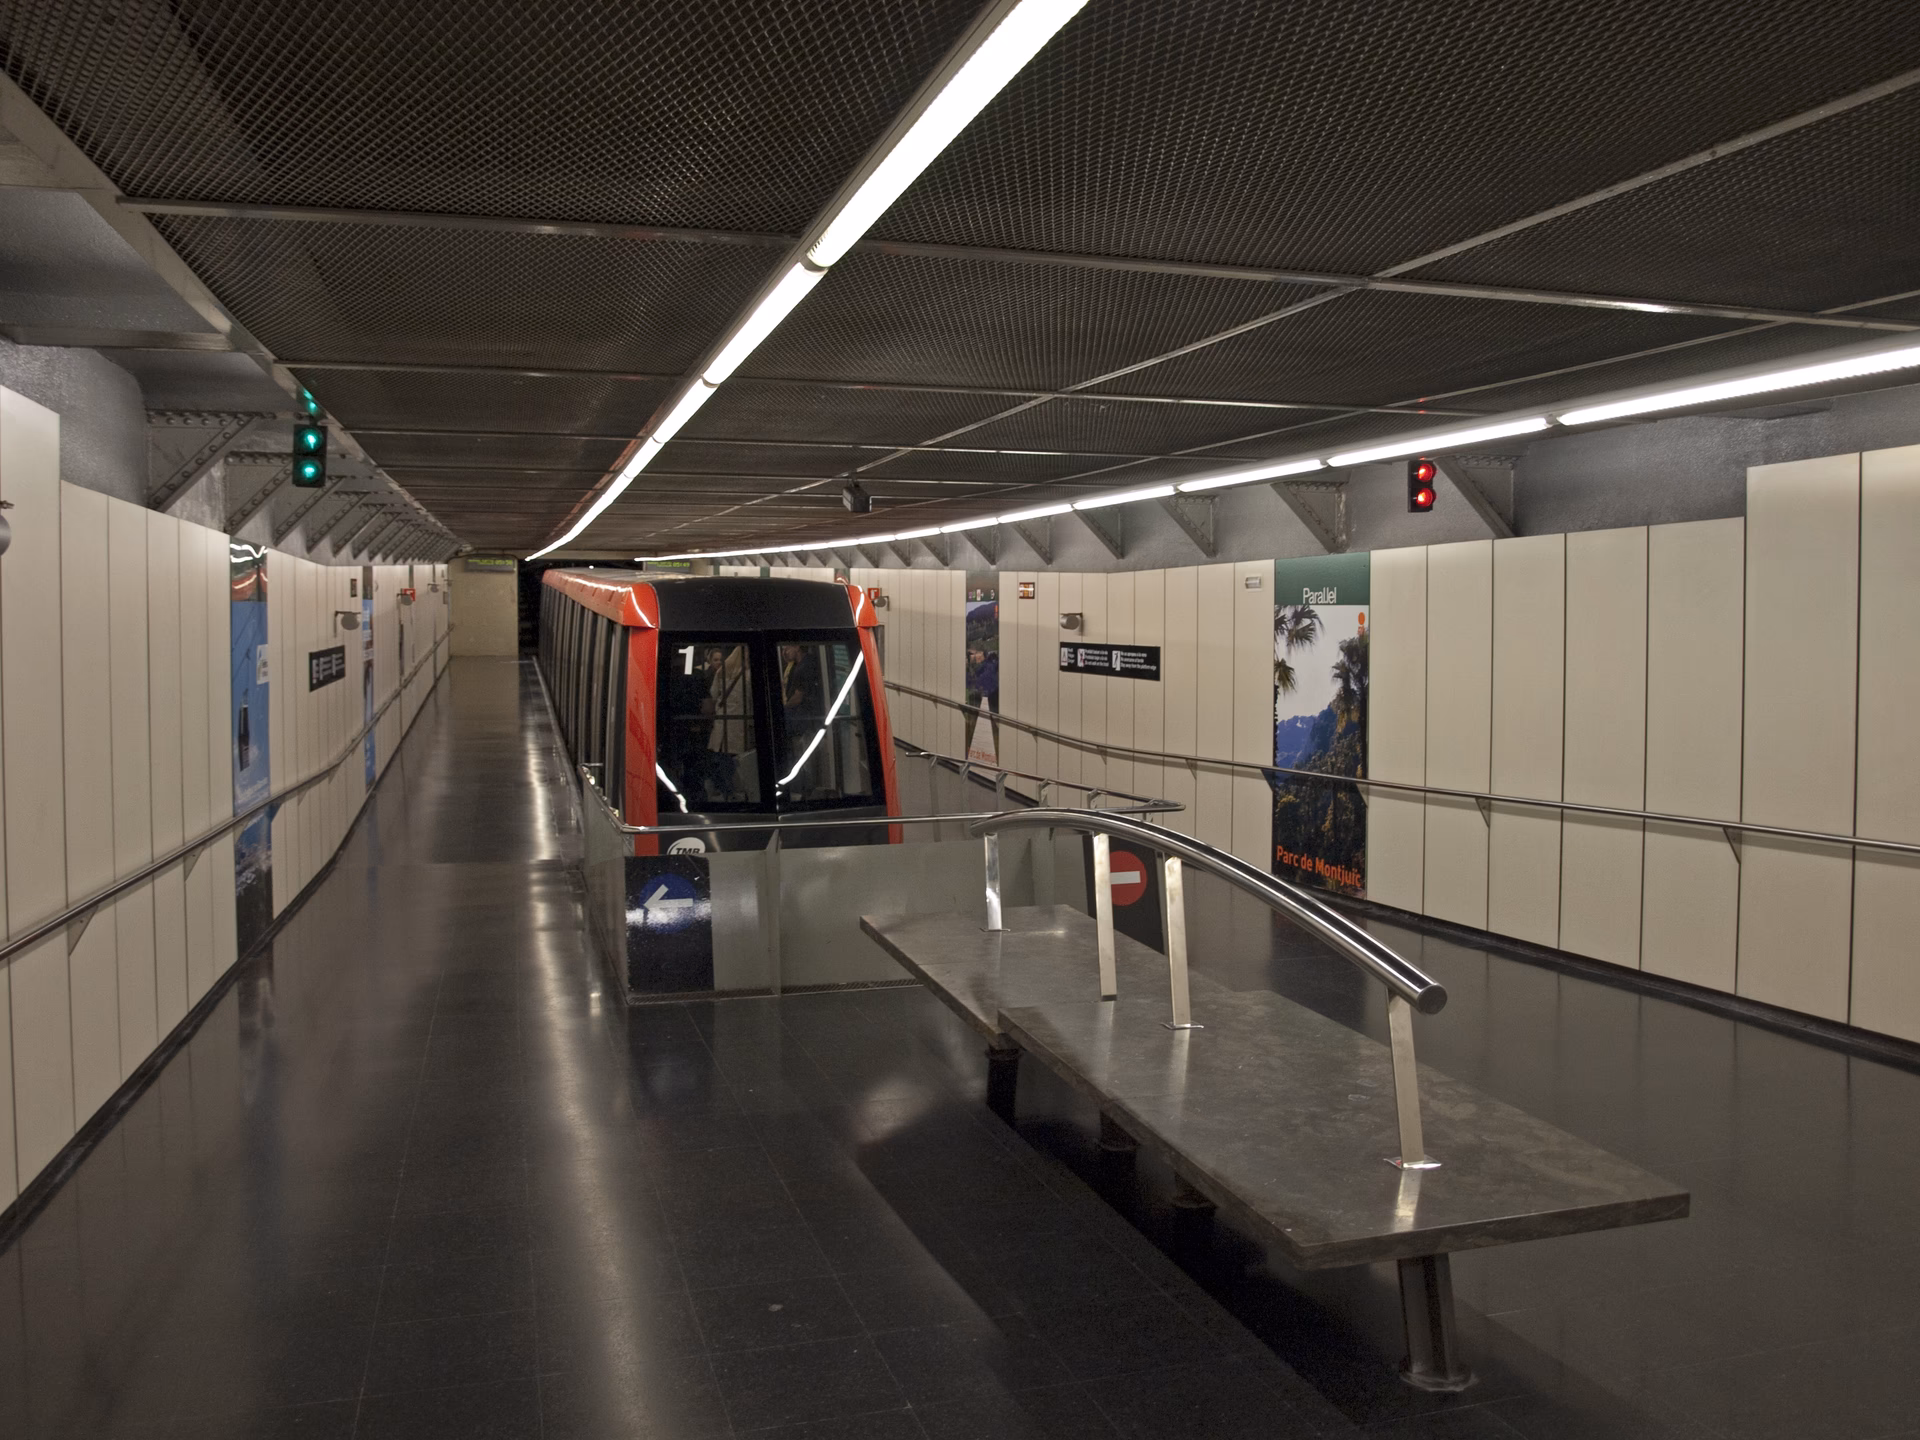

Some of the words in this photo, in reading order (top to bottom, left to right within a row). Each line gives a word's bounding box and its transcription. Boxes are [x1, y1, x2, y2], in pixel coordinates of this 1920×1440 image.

[678, 645, 695, 675] 1
[1275, 844, 1299, 867] Parc
[1300, 852, 1313, 872] de
[1315, 856, 1362, 888] Montjuïc
